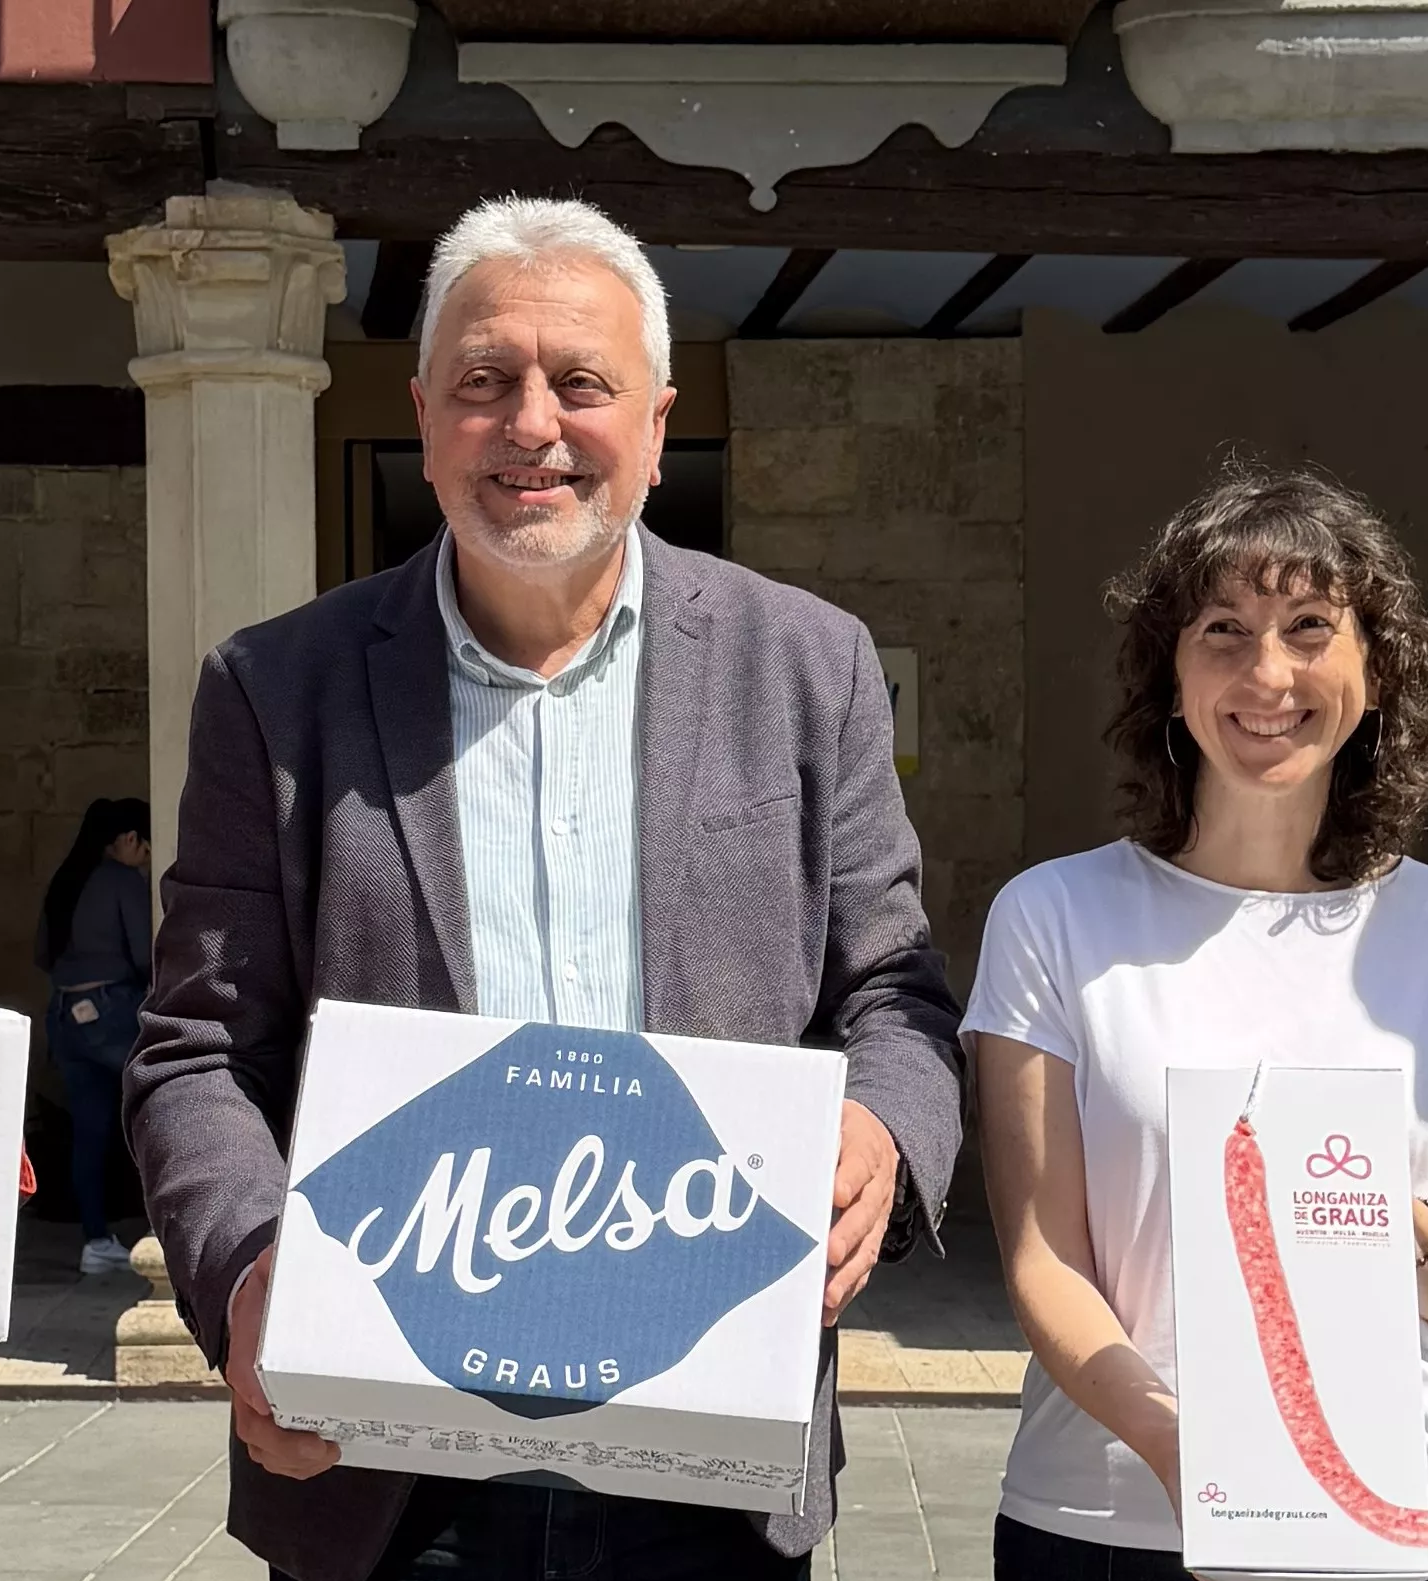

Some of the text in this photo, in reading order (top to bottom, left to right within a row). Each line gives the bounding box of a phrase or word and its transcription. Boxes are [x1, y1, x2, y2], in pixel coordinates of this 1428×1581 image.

[506, 1065, 643, 1097] FAMILIA
[1293, 1191, 1388, 1207] LONGANIZA
[1312, 1207, 1389, 1227] GRAUS
[462, 1348, 620, 1389] GRAUS
[1210, 1507, 1328, 1521] longanizadegraus.com
